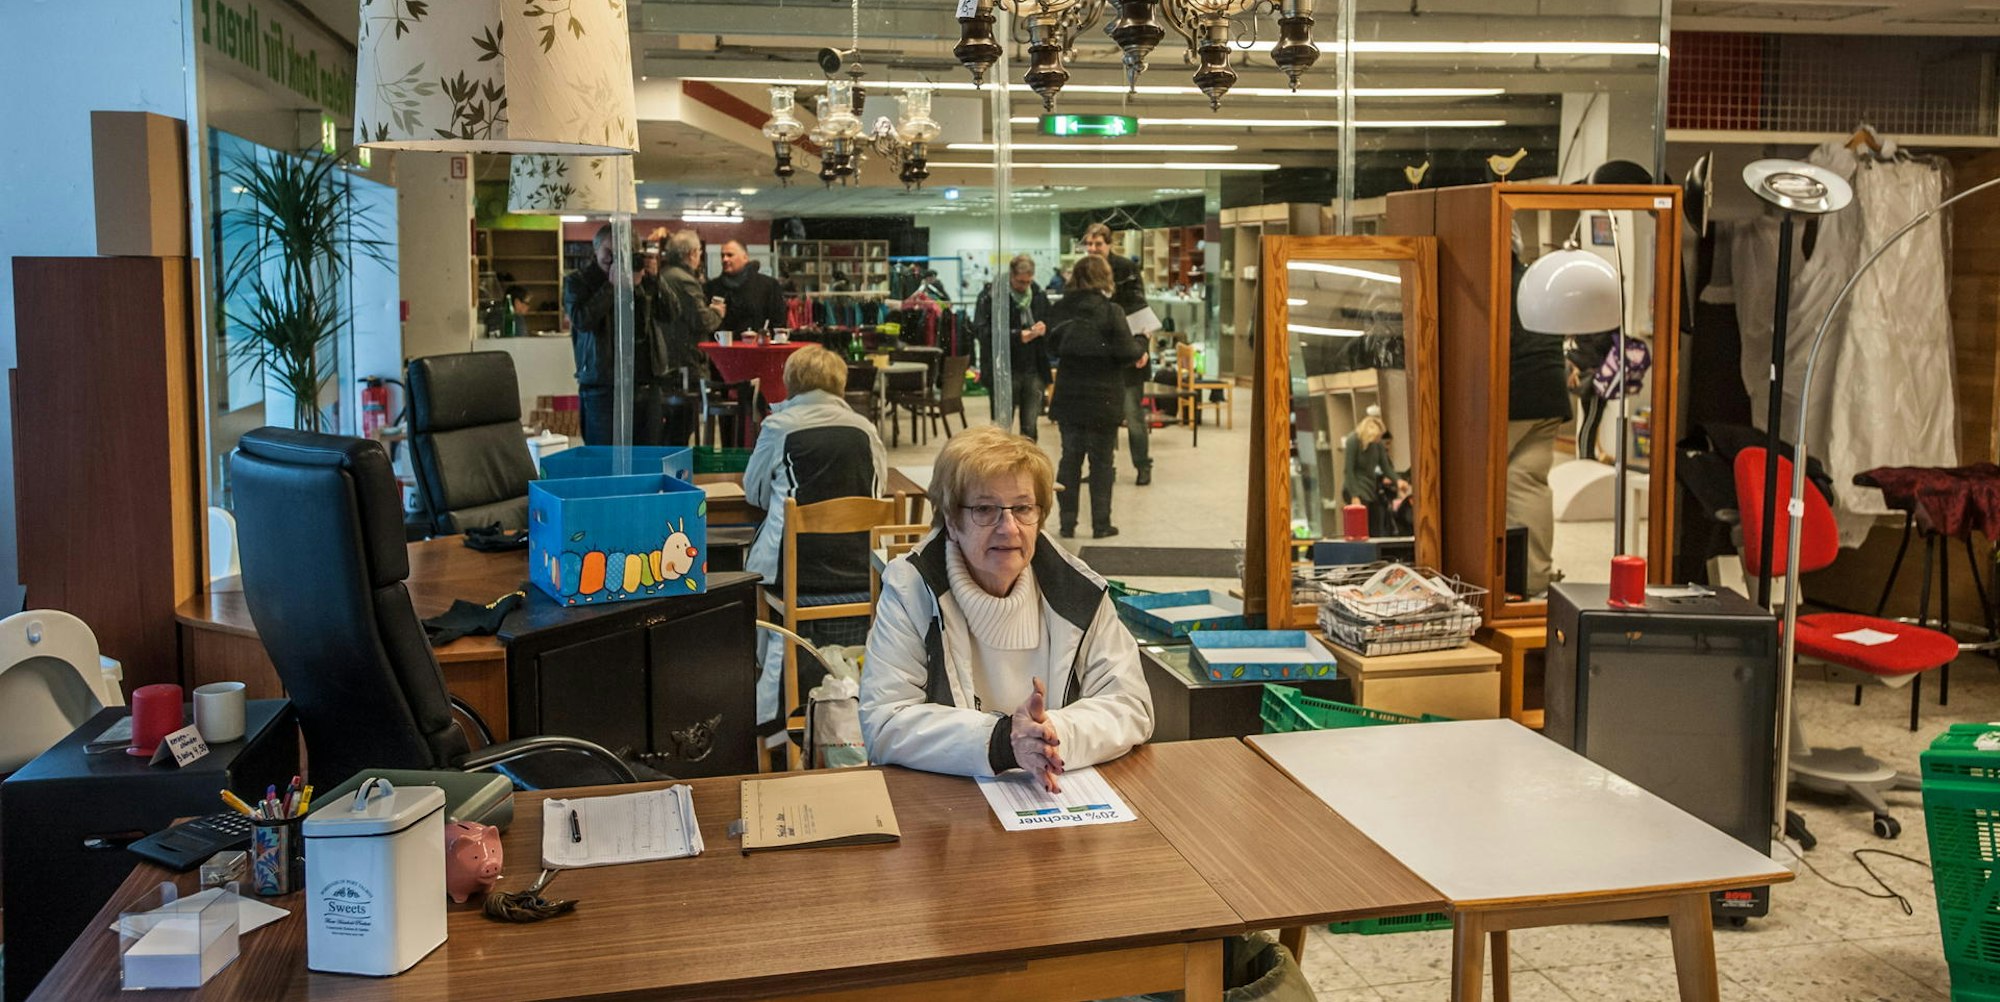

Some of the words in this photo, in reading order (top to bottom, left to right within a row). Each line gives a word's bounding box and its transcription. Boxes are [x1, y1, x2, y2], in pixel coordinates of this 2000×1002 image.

[1019, 813, 1083, 825] Rechner
[1085, 810, 1119, 822] 20%
[328, 901, 366, 914] Sweets
